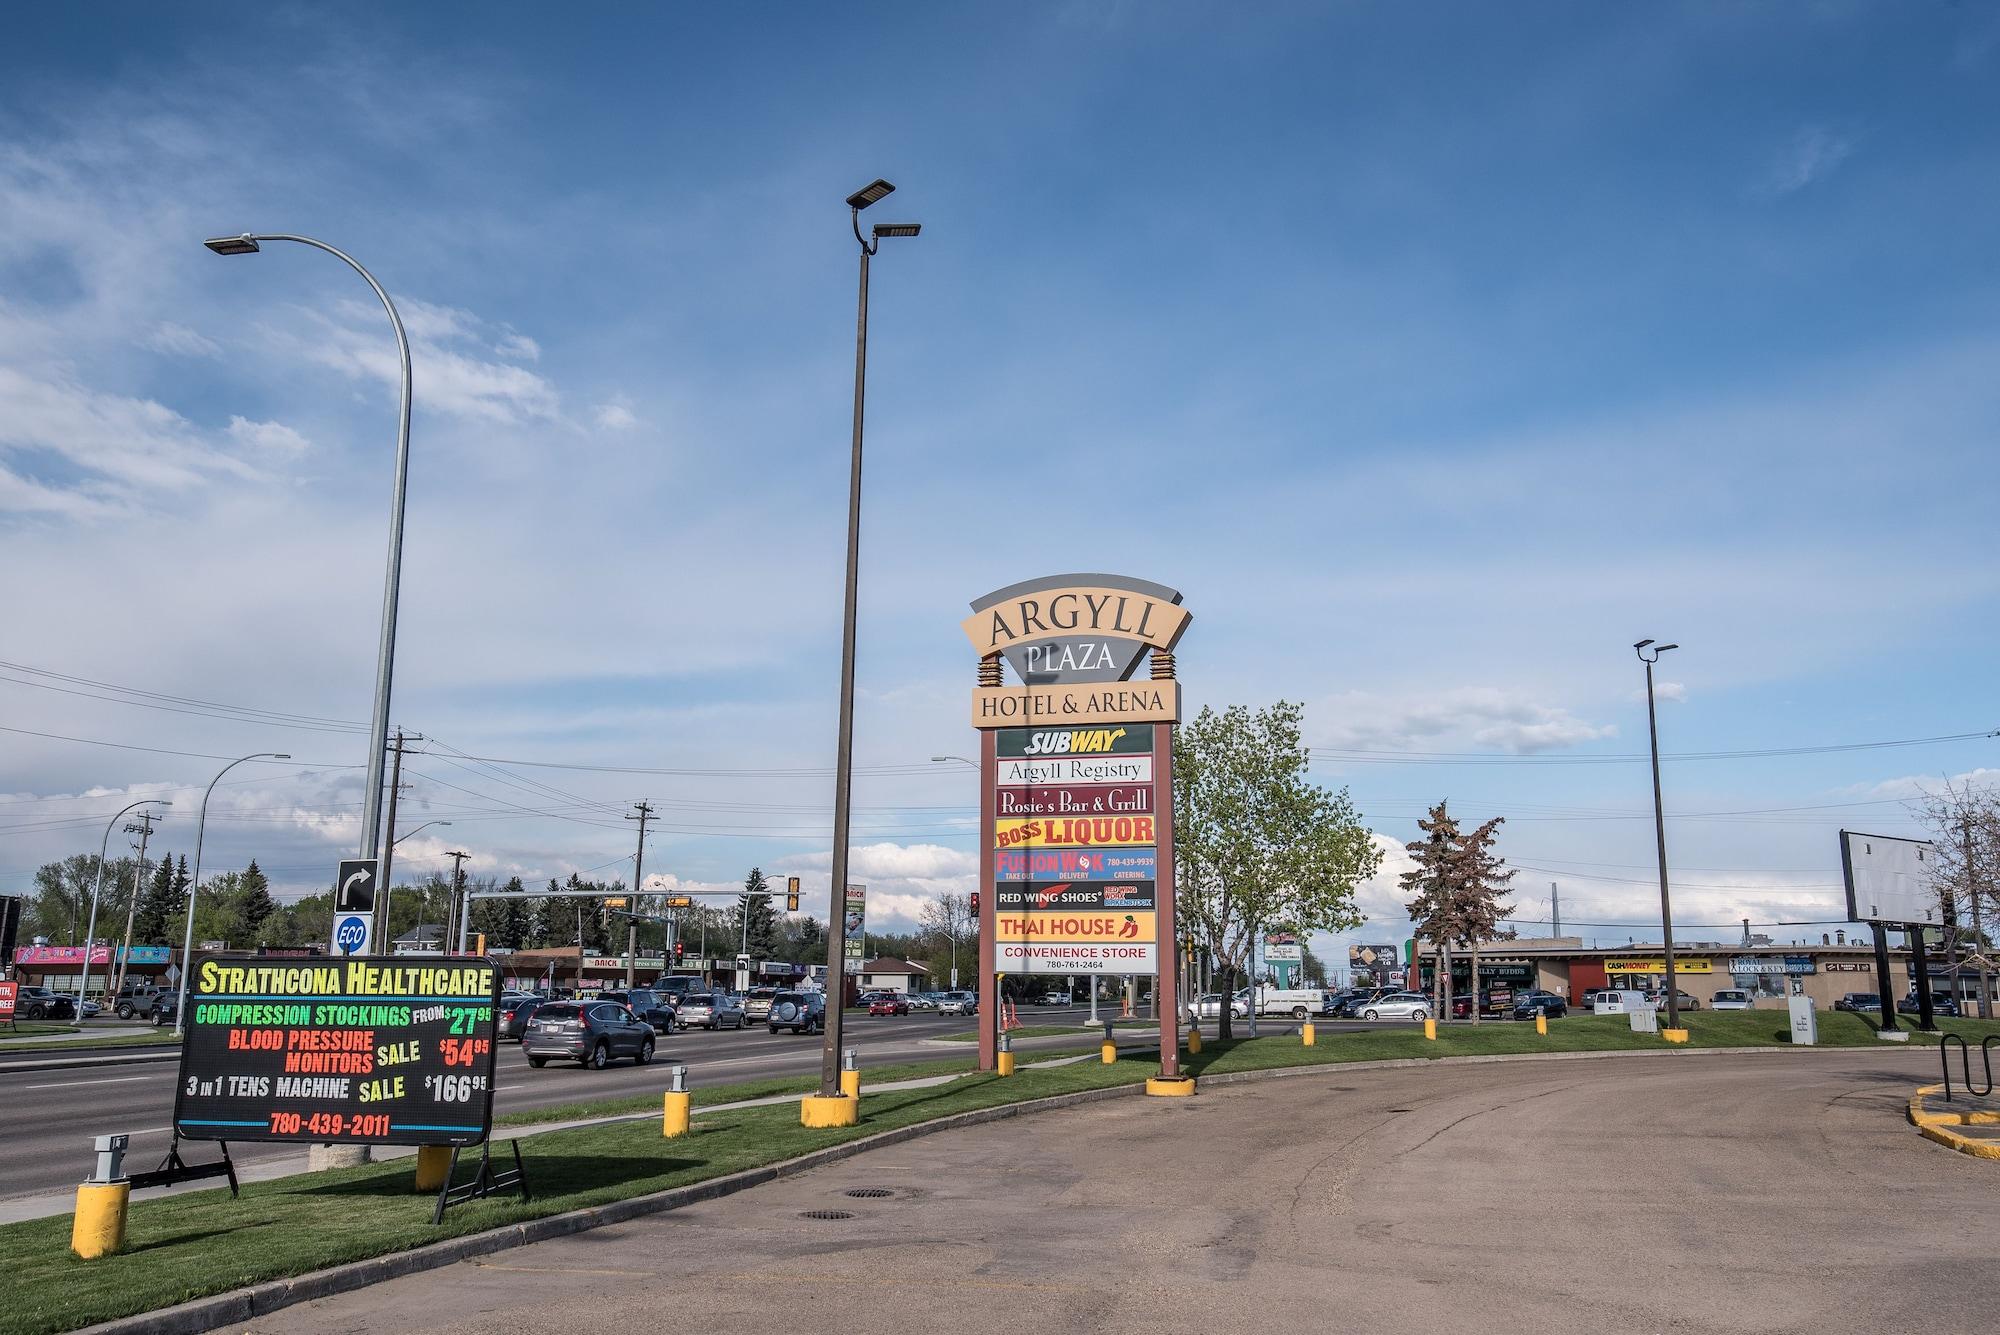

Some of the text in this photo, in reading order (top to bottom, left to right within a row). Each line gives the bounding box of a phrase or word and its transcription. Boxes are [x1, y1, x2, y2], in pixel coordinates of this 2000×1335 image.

[989, 594, 1157, 647] ARGYLL
[1026, 642, 1116, 673] PLAZA
[982, 690, 1164, 717] HOTEL & ARENA
[1024, 728, 1126, 755] SUBWAY
[1009, 760, 1141, 783] Argyll Registry
[1001, 788, 1147, 814] Rosie's Bar & Grill
[997, 817, 1154, 848] BOSS LIQUOR
[997, 851, 1057, 872] FUSION
[1107, 858, 1154, 866] 780-439-9939
[1059, 872, 1089, 880] DELIVERY
[999, 893, 1021, 903] RED
[1024, 893, 1058, 903] WING
[338, 926, 364, 944] ECO
[1000, 919, 1115, 935] THAI HOUSE
[594, 959, 617, 967] BRICK
[1005, 947, 1146, 958] CONVENIENCE STORE
[1046, 961, 1103, 969] 780-761-2464
[1391, 972, 1404, 980] Gla
[200, 961, 493, 995] STRATHCONA HEALTHCARE
[0, 1000, 14, 1009] REE!
[196, 1004, 311, 1025] COMPRESSION
[315, 1005, 410, 1026] STOCKINGS
[412, 1005, 444, 1024] FROM
[229, 1029, 374, 1051] BLOOD PRESSURE
[285, 1052, 374, 1074] MONITORS
[377, 1040, 420, 1066] SALE
[186, 1076, 198, 1096] 3
[215, 1075, 222, 1096] 1
[228, 1076, 270, 1097] TENS
[276, 1077, 350, 1098] MACHINE
[359, 1076, 405, 1102] SALE
[270, 1113, 390, 1136] 780-439-2011
